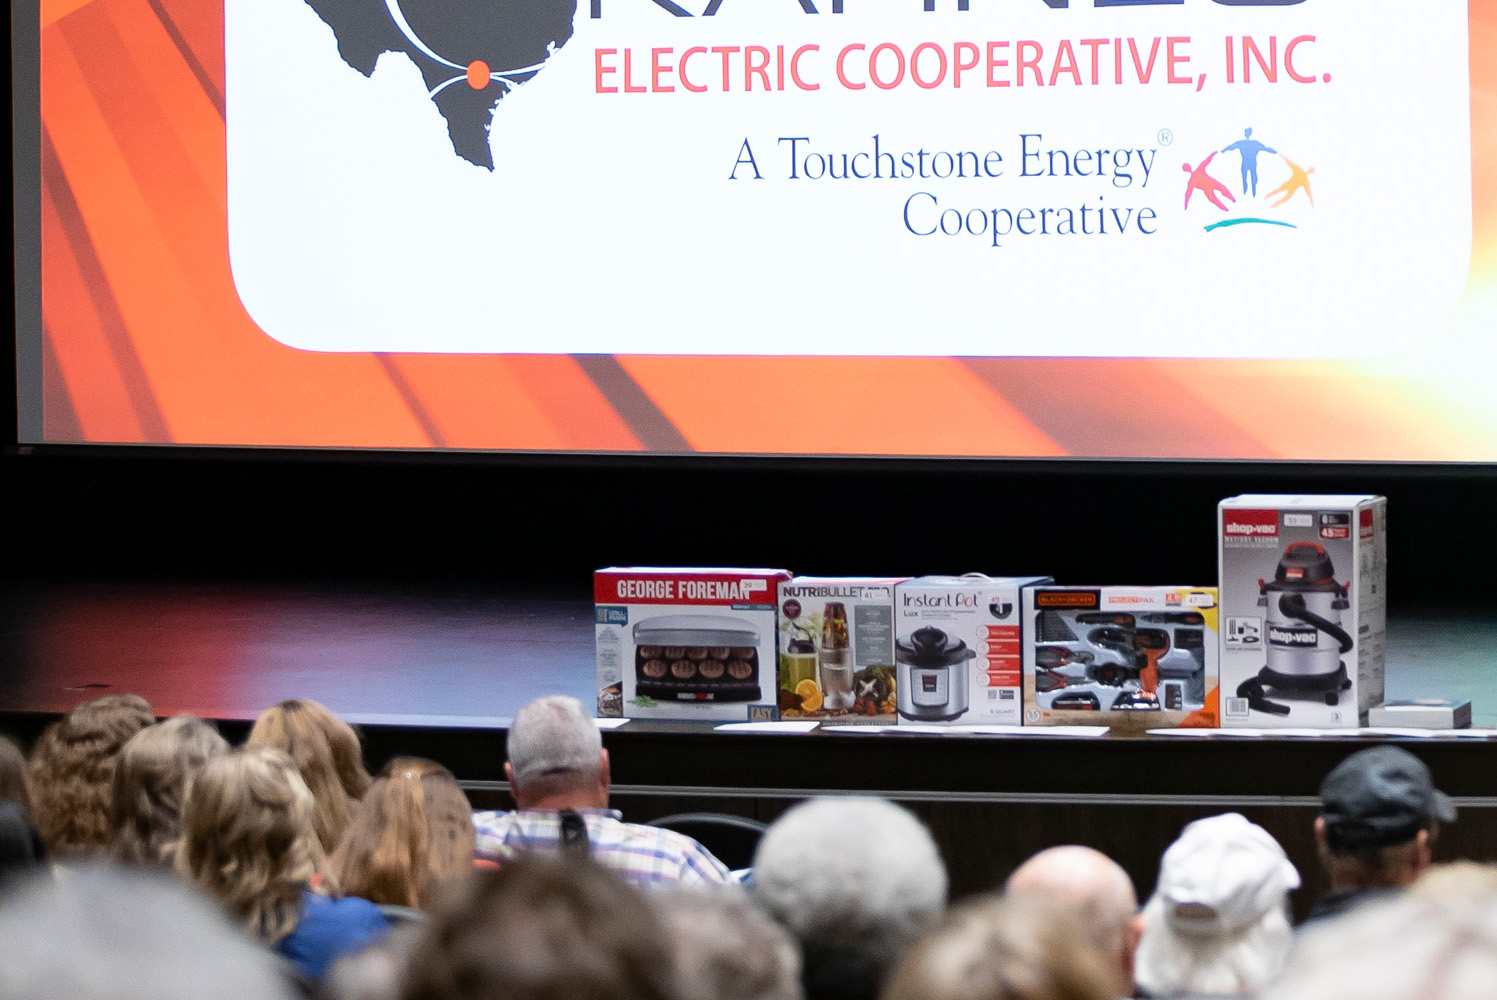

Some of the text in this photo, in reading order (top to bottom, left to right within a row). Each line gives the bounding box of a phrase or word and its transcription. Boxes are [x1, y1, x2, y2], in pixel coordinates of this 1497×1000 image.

[594, 34, 1333, 95] ELECTRIC COOPERATIVE, INC.
[728, 136, 765, 181] A
[777, 133, 1004, 181] Touchstone
[902, 190, 1159, 248] Cooperative
[616, 579, 675, 599] GEORGE
[903, 592, 952, 607] Instant
[955, 592, 979, 608] Pot
